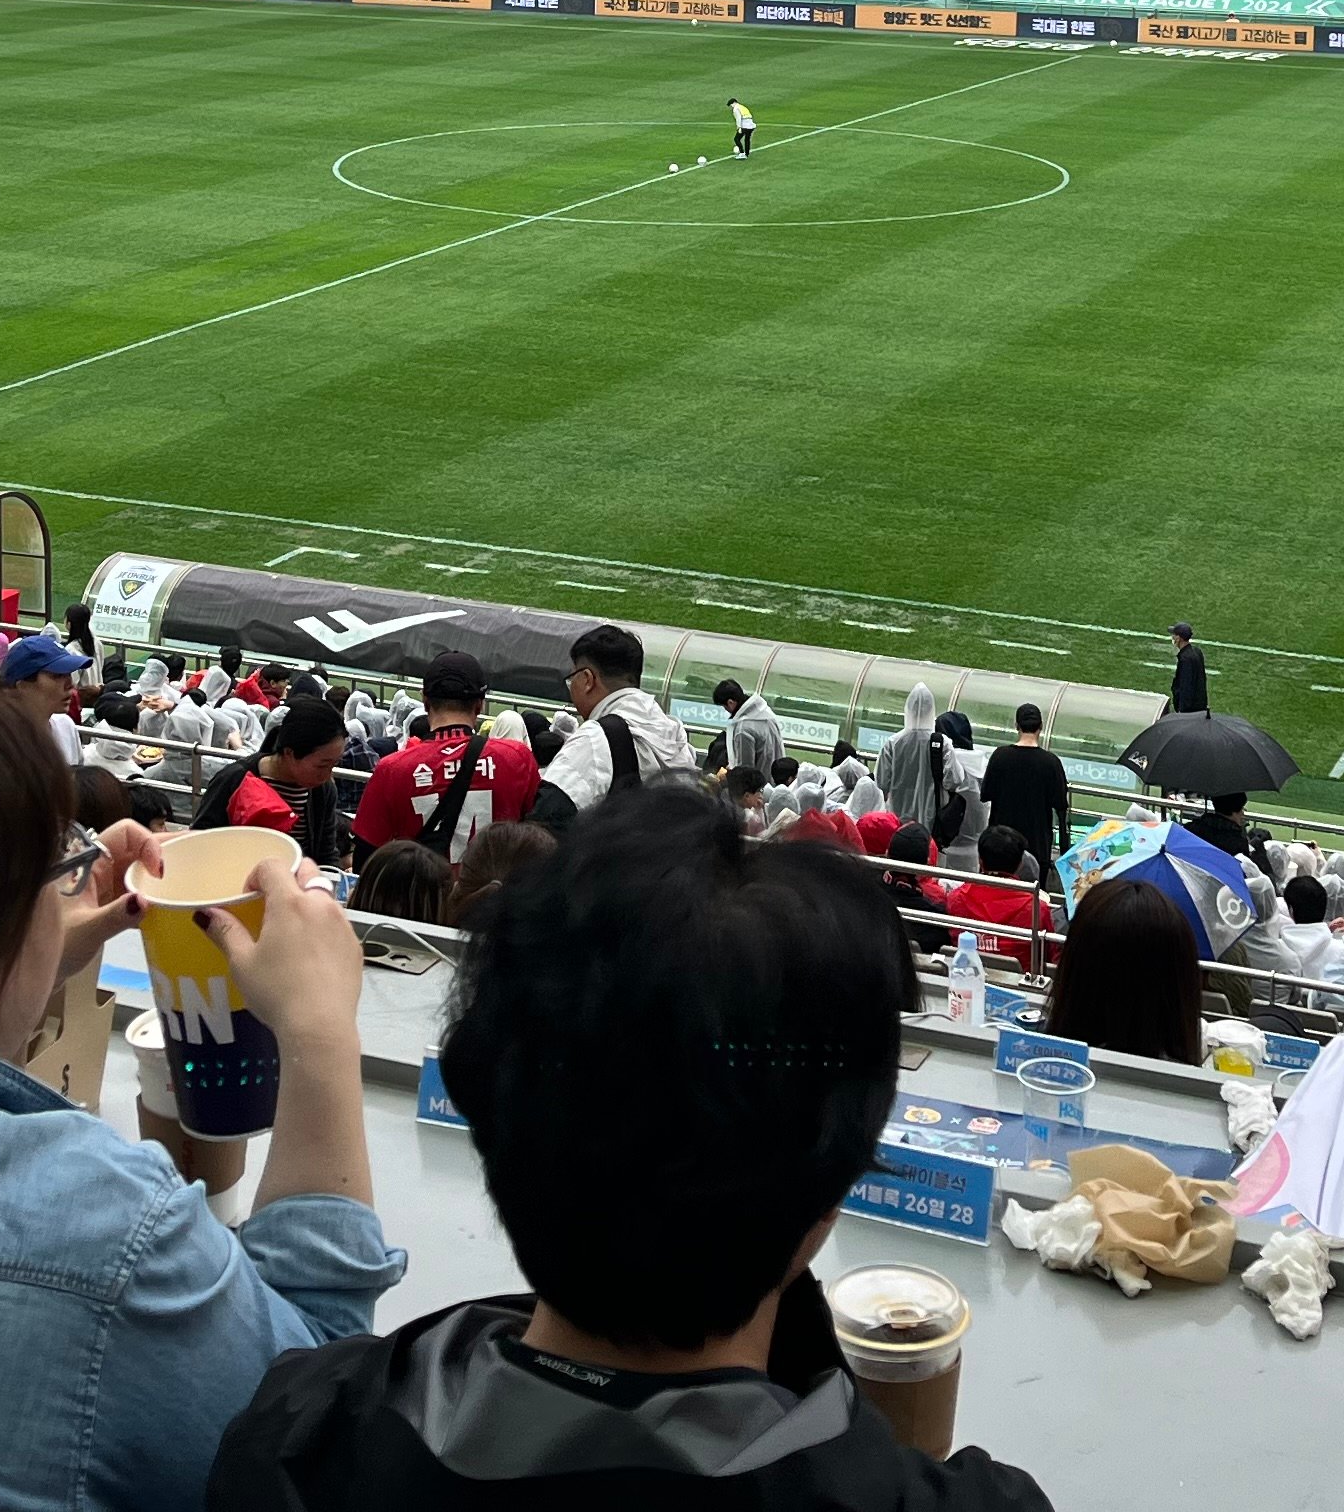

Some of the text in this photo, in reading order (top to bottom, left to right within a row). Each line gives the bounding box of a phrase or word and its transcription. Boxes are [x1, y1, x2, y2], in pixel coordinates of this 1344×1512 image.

[682, 1, 723, 16] 고집하는
[756, 5, 810, 21] 입단하시죠
[1032, 19, 1094, 36] 국대급 한돈
[1148, 24, 1173, 39] 국산
[1241, 29, 1290, 45] 고집하는
[96, 603, 148, 619] 전북현대모터스
[850, 1184, 974, 1226] M블록 26열 28
